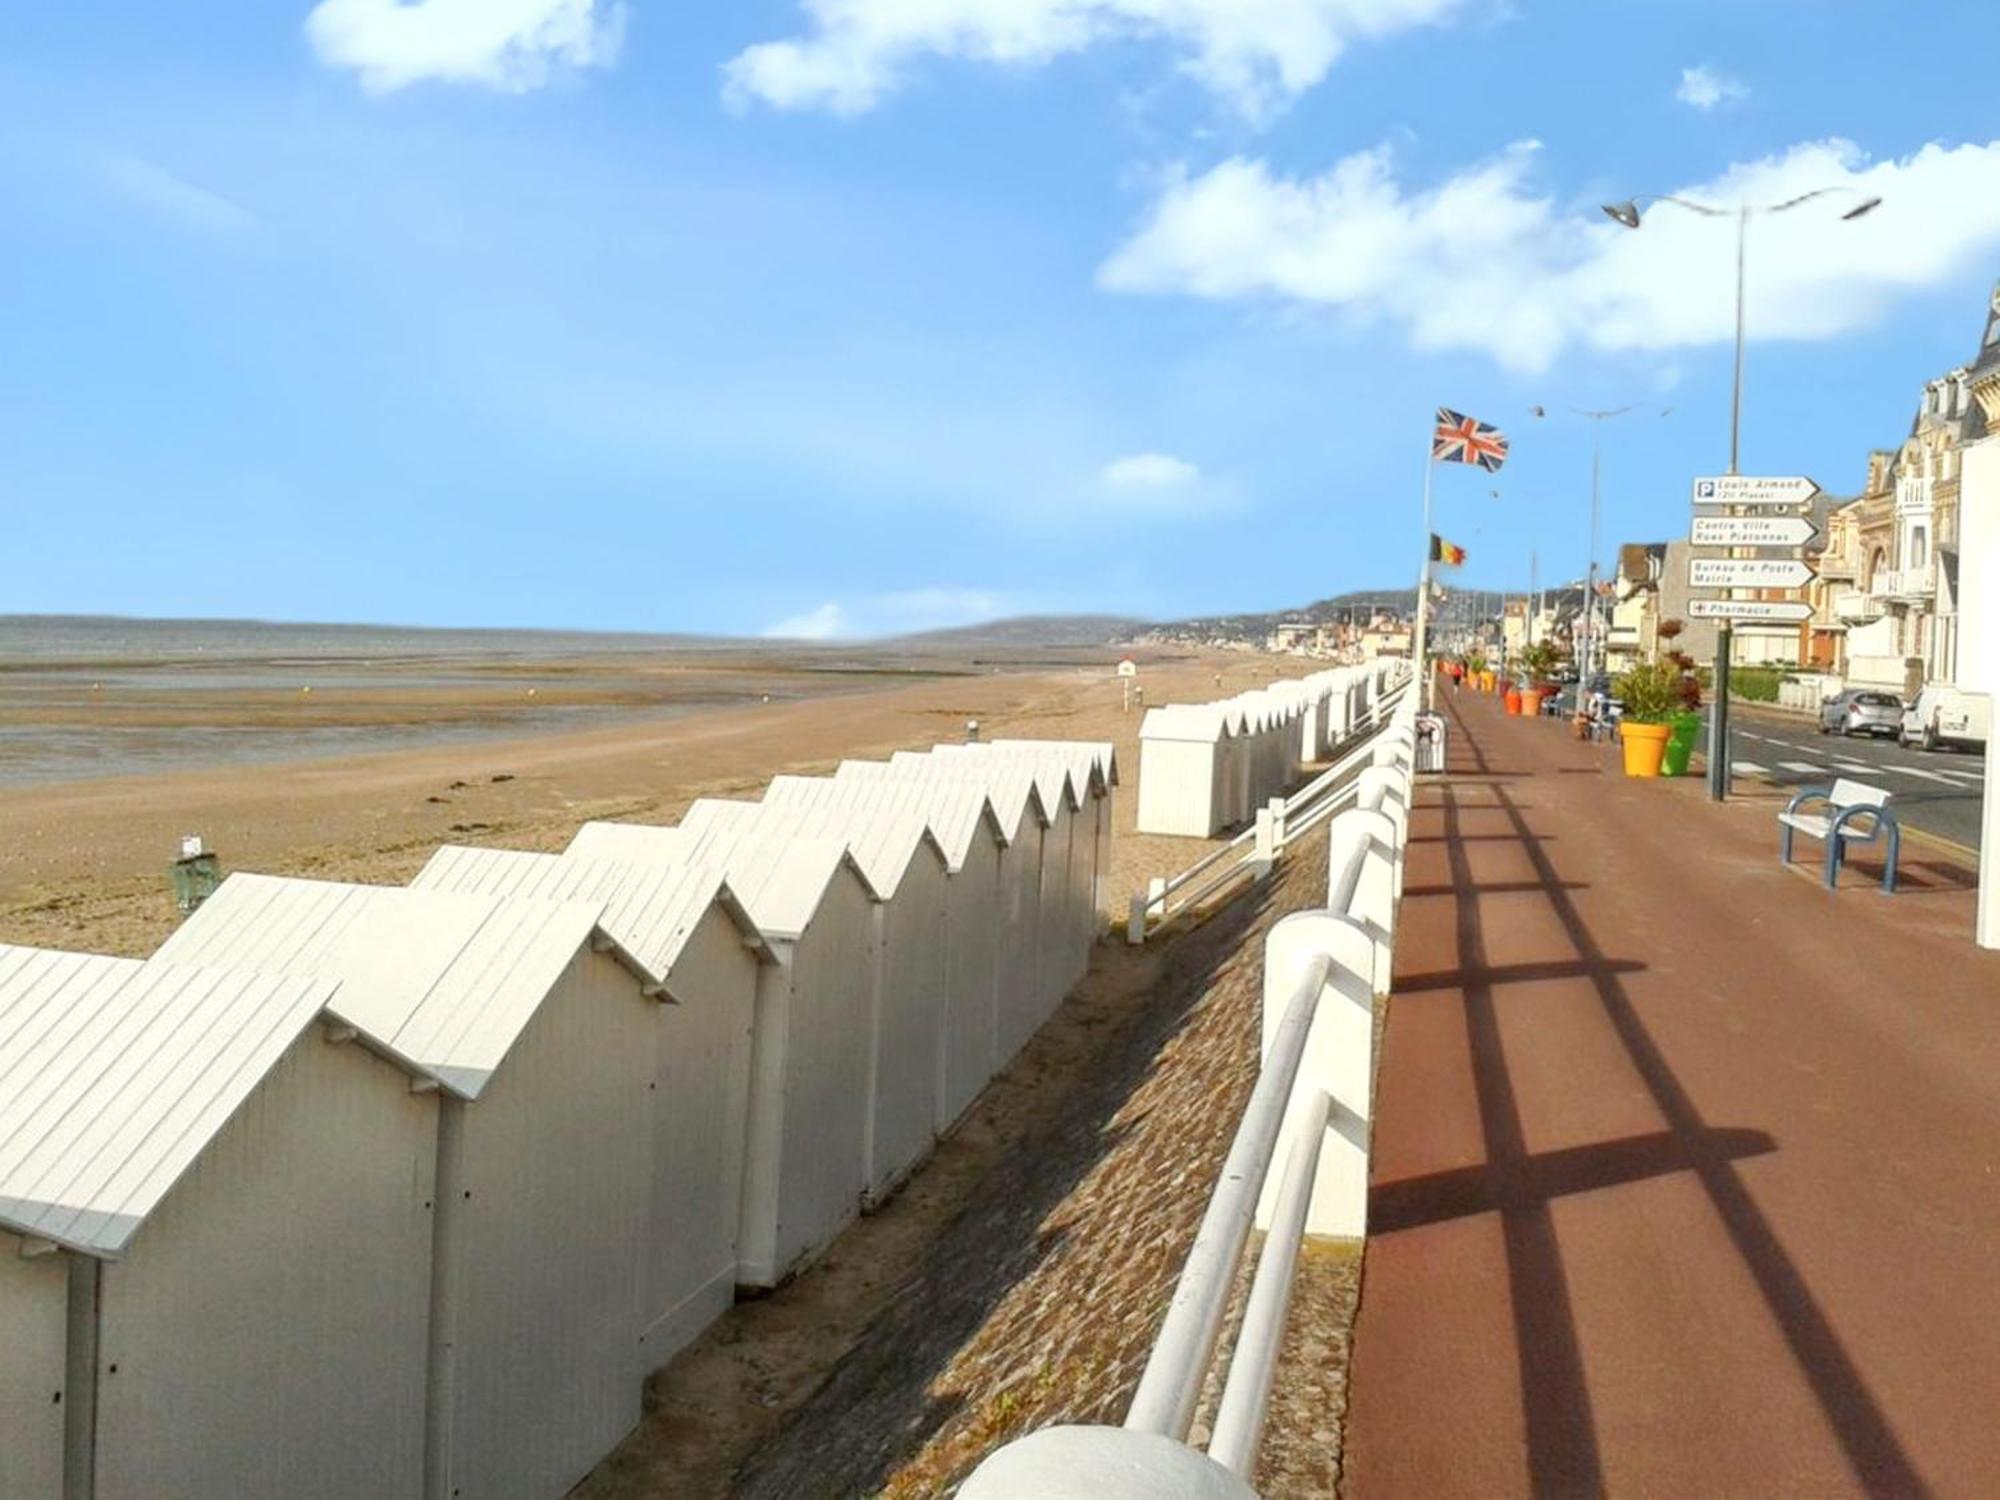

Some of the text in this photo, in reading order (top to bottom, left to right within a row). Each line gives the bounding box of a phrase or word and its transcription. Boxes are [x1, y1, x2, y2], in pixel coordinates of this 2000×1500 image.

[1696, 520, 1770, 530] Centre Ville
[1695, 532, 1723, 541] Rues
[1694, 562, 1794, 573] Bureau de Poste
[1694, 573, 1732, 582] Mairie
[1709, 604, 1771, 614] Pharmacie
